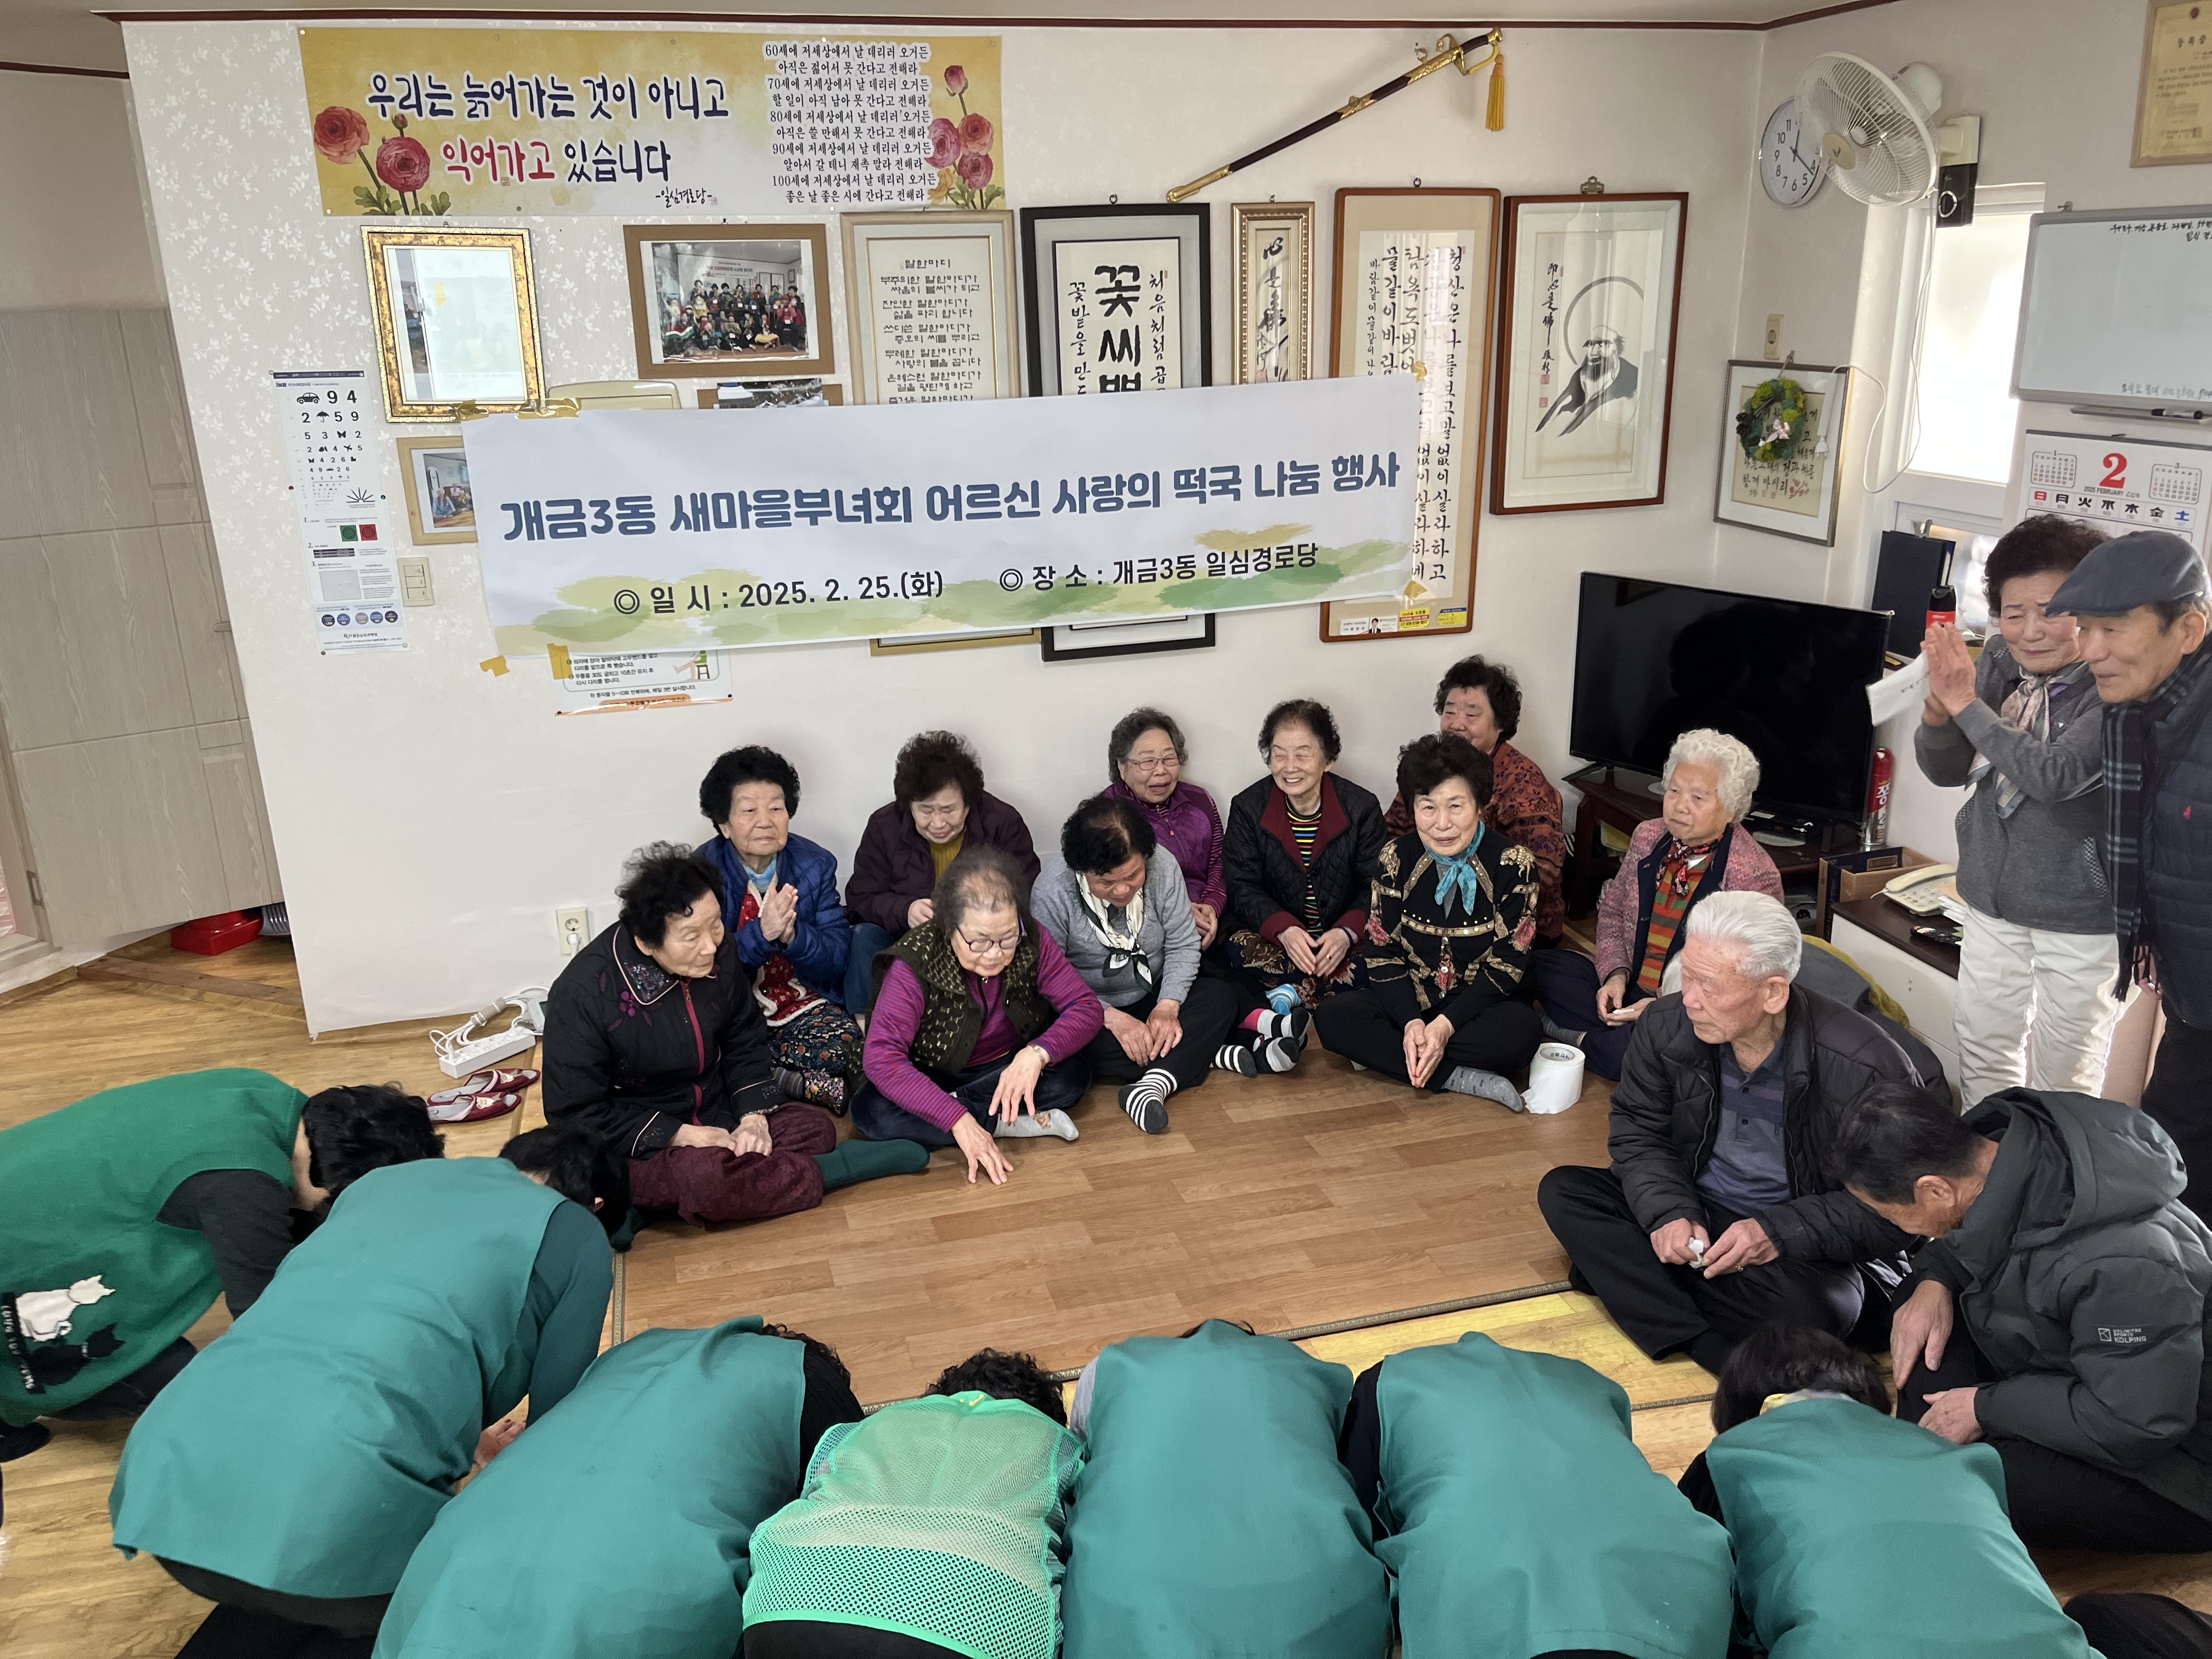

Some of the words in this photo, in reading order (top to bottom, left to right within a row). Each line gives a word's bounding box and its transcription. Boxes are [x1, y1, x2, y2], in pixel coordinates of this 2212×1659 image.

[766, 44, 797, 57] 60세에
[803, 44, 849, 58] 저세상에서
[855, 46, 864, 58] 날
[868, 46, 894, 59] 데리러
[900, 46, 928, 59] 오거든
[779, 61, 808, 74] 아직은
[812, 61, 838, 75] 젊어서
[844, 62, 853, 74] 못
[857, 62, 885, 75] 간다고
[889, 63, 917, 75] 전해라
[768, 77, 799, 91] 70세에
[804, 78, 851, 91] 저세상에서
[856, 78, 865, 91] 날
[870, 78, 895, 91] 데리러
[901, 78, 928, 91] 오거든
[369, 74, 453, 117] 우리는
[464, 74, 575, 119] 늙어가는
[583, 76, 637, 119] 것이
[649, 77, 728, 119] 아니고
[772, 93, 781, 106] 할
[786, 94, 803, 107] 일이
[809, 94, 826, 107] 아직
[831, 94, 850, 107] 남아
[854, 94, 862, 107] 못
[867, 94, 895, 107] 간다고
[899, 94, 927, 107] 전해라
[771, 110, 801, 123] 80세에
[806, 110, 853, 123] 저세상에서
[858, 110, 866, 123] 날
[871, 110, 897, 123] 데리러
[903, 110, 930, 123] 오거든
[1786, 119, 1791, 132] 11
[777, 126, 805, 139] 아직은
[809, 127, 818, 139] 쓸
[822, 127, 849, 139] 만해서
[854, 127, 862, 139] 못
[867, 126, 895, 139] 간다고
[899, 126, 926, 139] 전해라
[1778, 132, 1786, 144] 10
[773, 143, 803, 155] 90세에
[809, 143, 854, 155] 저세상에서
[860, 142, 868, 154] 날
[873, 142, 899, 155] 데리러
[904, 142, 931, 155] 오거든
[442, 137, 555, 181] 익어가고
[565, 139, 671, 182] 있습니다
[1775, 150, 1780, 162] 9
[784, 159, 811, 171] 알아서
[816, 159, 825, 171] 갈
[828, 159, 846, 171] 테니
[851, 158, 869, 171] 재촉
[873, 158, 891, 170] 말라
[895, 158, 923, 170] 전해라
[1810, 160, 1815, 171] 4
[1776, 165, 1781, 177] 8
[773, 174, 809, 187] 100세에
[814, 174, 859, 187] 저세상에서
[865, 174, 873, 186] 날
[877, 173, 904, 186] 데리러
[909, 173, 936, 186] 오거든
[1783, 176, 1788, 188] 7
[1792, 179, 1797, 191] 6
[1802, 173, 1807, 185] 5
[786, 191, 804, 203] 좋은
[809, 190, 817, 202] 날
[821, 190, 839, 202] 좋은
[844, 190, 861, 202] 시에
[866, 189, 893, 201] 간다고
[897, 189, 924, 201] 전해라
[905, 259, 950, 268] 말한마디
[881, 276, 919, 285] 부주의한
[926, 275, 977, 284] 말한마디가
[962, 285, 979, 293] 되고
[883, 300, 912, 309] 잔인한
[918, 298, 967, 308] 말한마디가
[894, 311, 912, 320] 삶을
[918, 310, 937, 319] 파괴
[943, 309, 972, 318] 합니다
[884, 325, 912, 333] 쓰디쓴
[919, 324, 970, 332] 말한마디가
[895, 335, 923, 344] 증오의
[952, 334, 980, 342] 뿌리고
[885, 349, 915, 358] 무례한
[921, 348, 972, 357] 말한마디가
[896, 360, 925, 369] 사랑의
[931, 371, 980, 381] 말한마디가
[898, 383, 915, 392] 길을
[954, 382, 973, 391] 하고
[327, 391, 337, 404] 9
[347, 390, 357, 403] 4
[302, 413, 311, 422] 2
[335, 411, 342, 422] 5
[351, 411, 359, 421] 9
[2099, 453, 2128, 489] 2
[500, 496, 656, 540] 개금3동
[670, 487, 912, 532] 새마을부녀회
[927, 480, 1040, 521] 어르신
[1052, 471, 1160, 514] 사랑의
[1174, 465, 1242, 504] 떡국
[1255, 460, 1320, 497] 나눔
[1331, 452, 1400, 492] 행사
[2097, 488, 2124, 496] FEBRUARY
[2034, 491, 2047, 501] 日
[2056, 494, 2069, 504] 月
[2078, 497, 2091, 507] 火
[2101, 500, 2115, 510] 水
[2125, 504, 2139, 514] 木
[2150, 507, 2165, 518] 金
[2175, 510, 2190, 521] 土
[1033, 566, 1056, 591] 장
[1065, 565, 1087, 588] 소
[1114, 555, 1196, 584] 개금3동
[1205, 542, 1319, 578] 일심경로당
[651, 587, 675, 613] 일
[687, 585, 710, 611] 시
[739, 582, 815, 607] 2025.
[825, 579, 848, 601] 2.
[859, 571, 943, 599] 25.(화)
